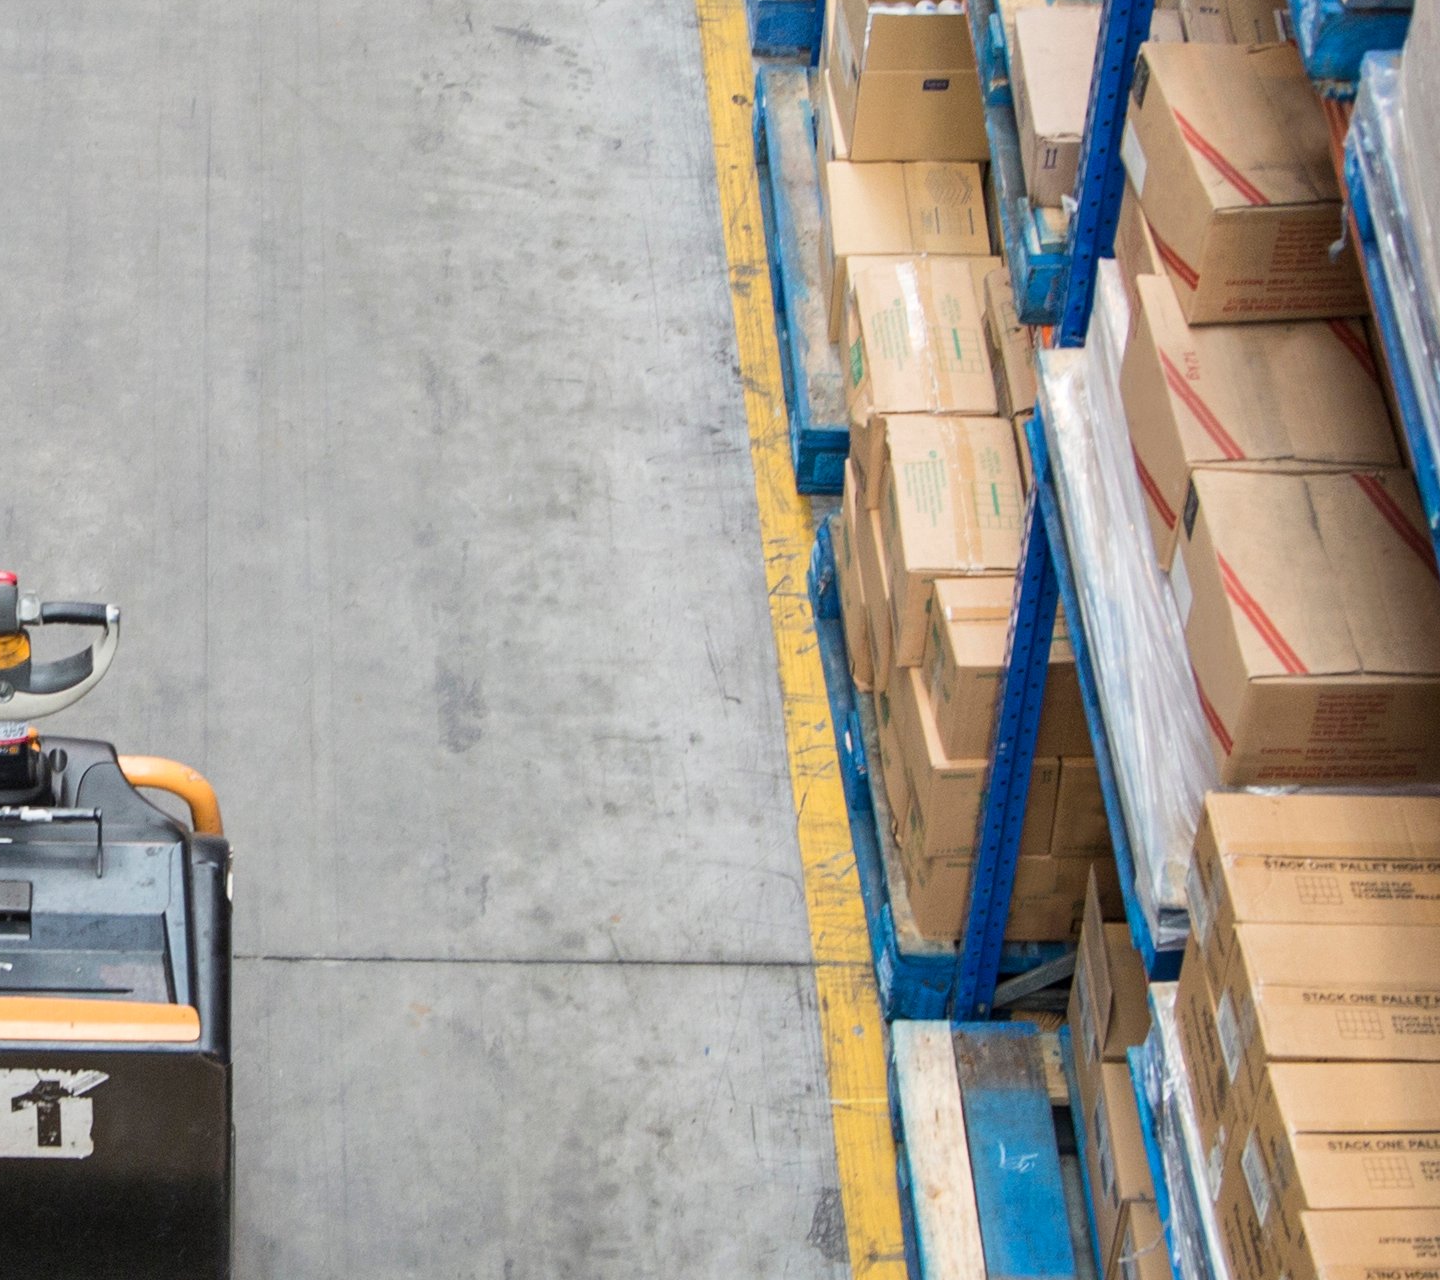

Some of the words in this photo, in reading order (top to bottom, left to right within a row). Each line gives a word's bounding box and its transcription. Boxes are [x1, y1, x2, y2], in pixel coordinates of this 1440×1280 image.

[1339, 862, 1388, 872] PALLET
[1302, 992, 1345, 1002] STACK
[1349, 994, 1377, 1003] ONE
[1381, 995, 1431, 1005] PALLET
[1327, 1140, 1371, 1151] STACK
[1376, 1140, 1405, 1151] ONE
